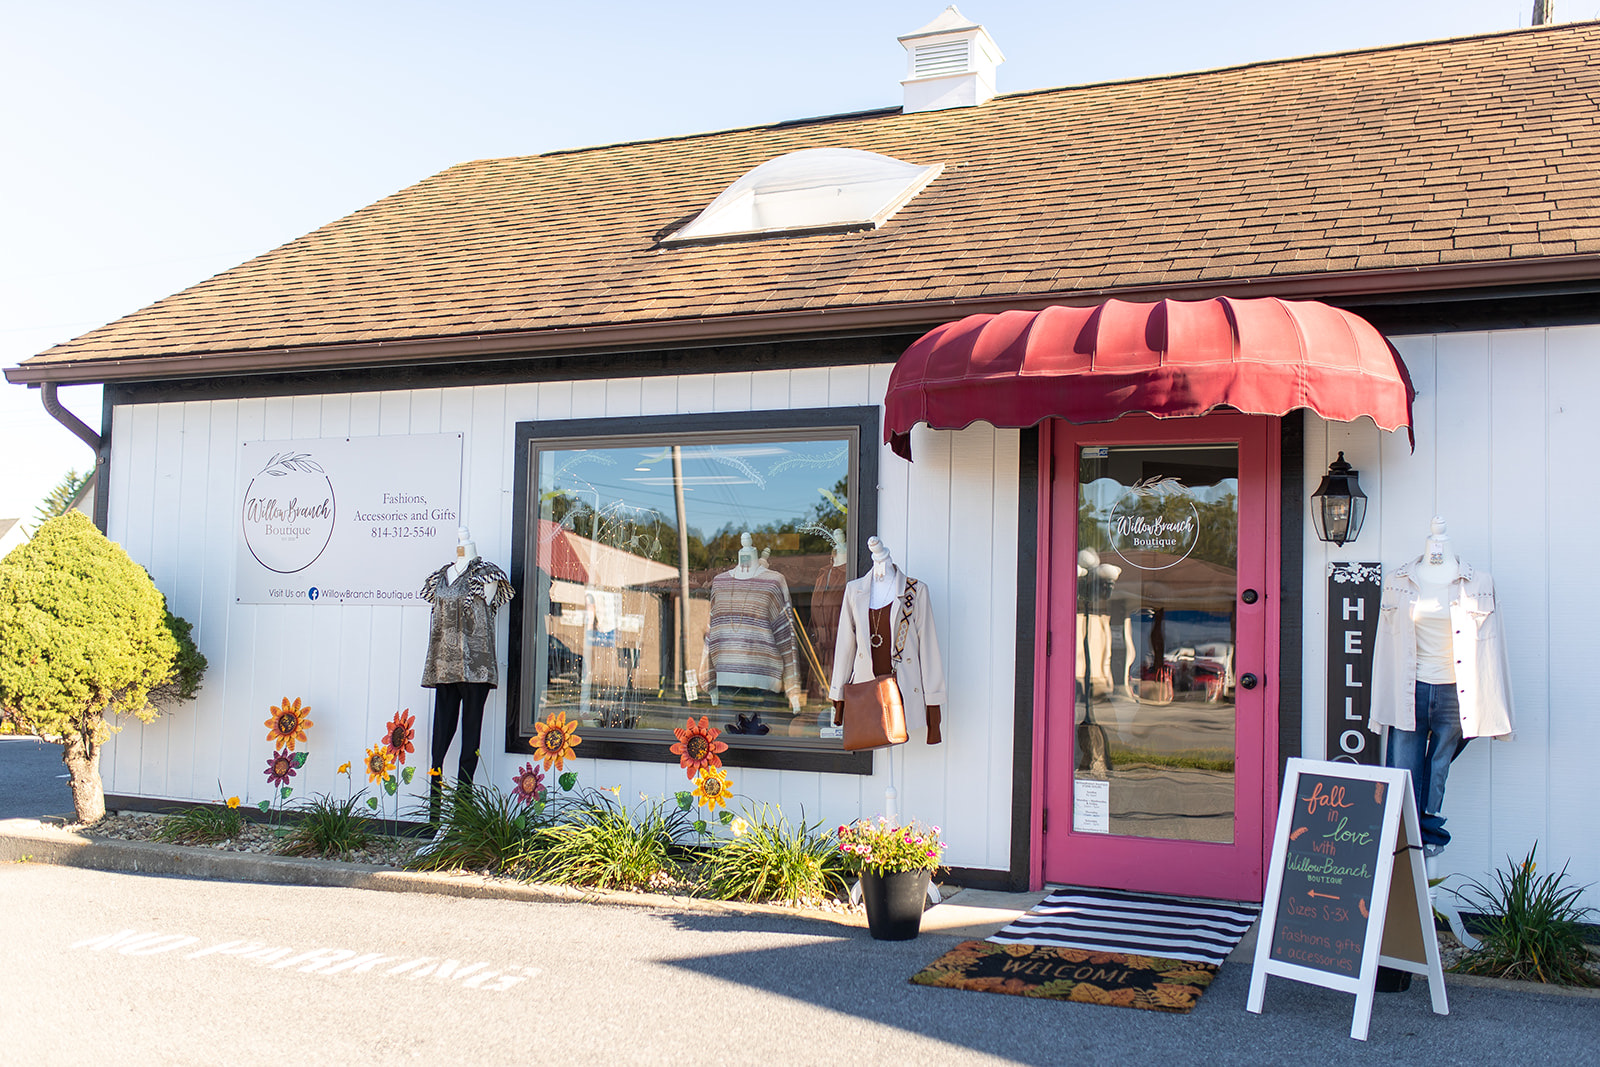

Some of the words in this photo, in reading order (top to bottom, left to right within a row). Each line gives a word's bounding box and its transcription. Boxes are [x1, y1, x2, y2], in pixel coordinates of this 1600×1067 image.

[383, 493, 427, 504] Fashions,
[248, 497, 331, 523] WillowBranch
[353, 510, 408, 521] Accessories
[410, 508, 429, 520] and
[431, 508, 456, 520] Gifts
[265, 523, 311, 539] Boutique
[371, 526, 437, 538] 814-312-5540
[1117, 515, 1195, 536] WillowBranch
[1133, 537, 1177, 548] Boutique
[269, 589, 284, 598] Visit
[285, 589, 294, 598] Us
[295, 590, 306, 598] on
[321, 589, 375, 599] WillowBranch
[376, 590, 413, 600] Boutique
[1339, 598, 1366, 754] HELLO
[1301, 782, 1355, 815] fall
[1327, 808, 1339, 822] in
[1322, 816, 1374, 845] love
[1312, 840, 1337, 856] with
[1307, 874, 1344, 885] BOUTIQUE
[1287, 896, 1318, 919] Sizes
[1335, 938, 1361, 955] gifts
[68, 929, 201, 956] NO
[184, 938, 544, 992] PARKING
[1287, 947, 1353, 972] accessories
[1001, 958, 1135, 984] WELCOME
